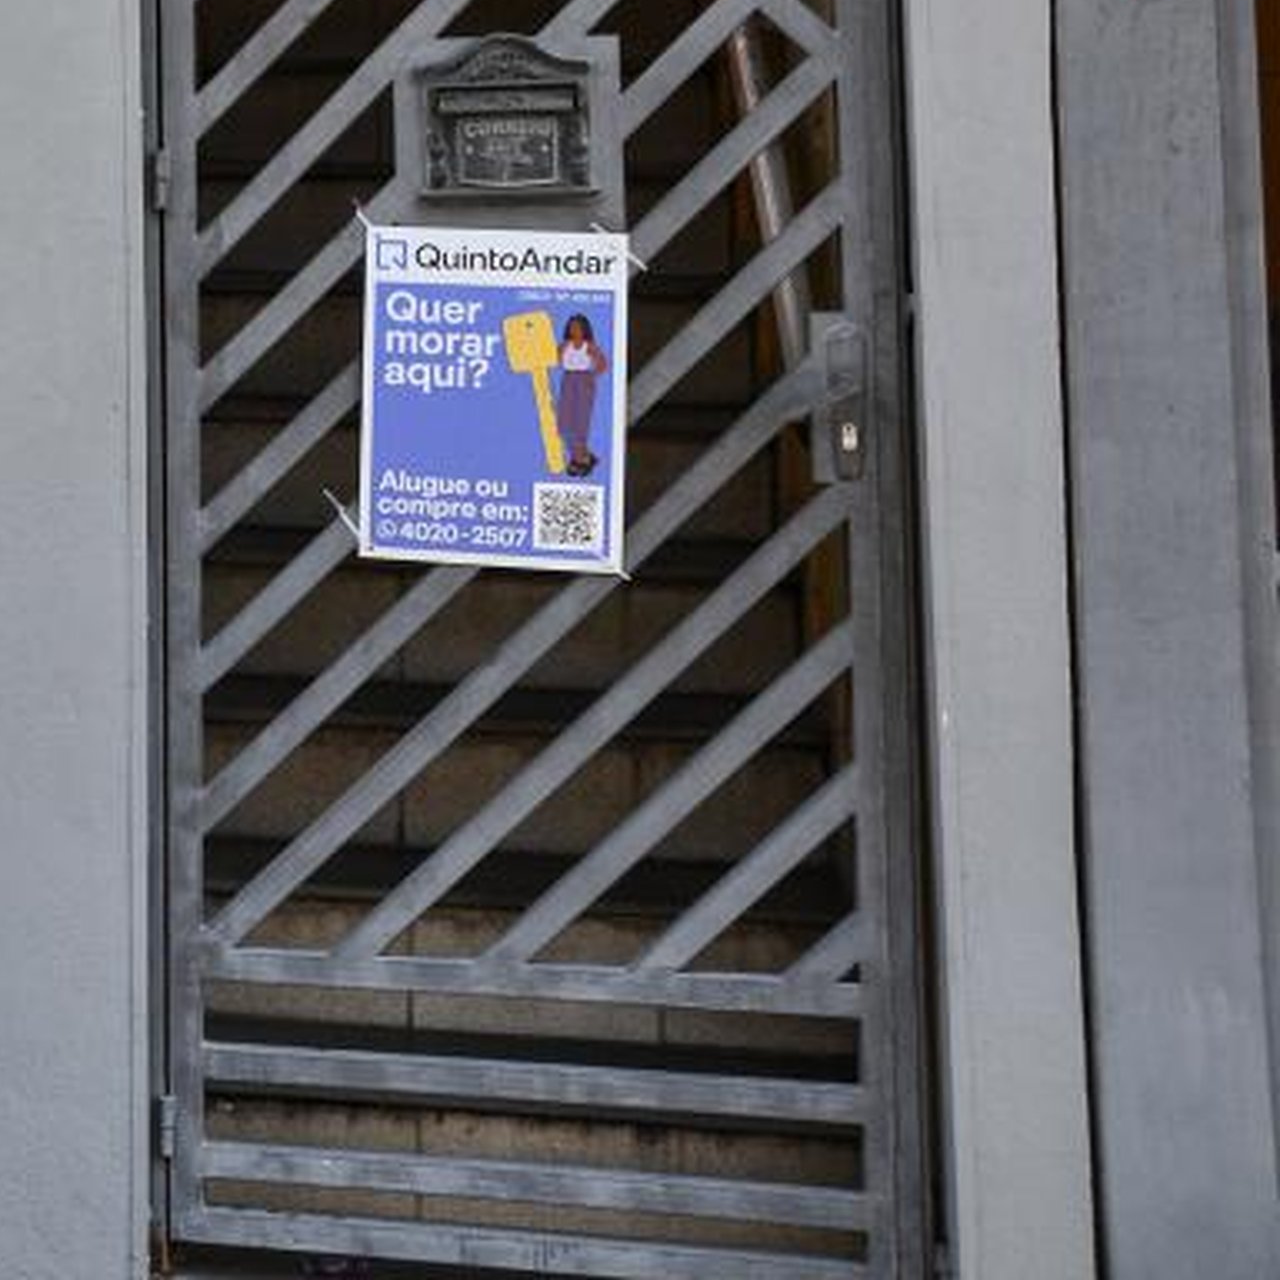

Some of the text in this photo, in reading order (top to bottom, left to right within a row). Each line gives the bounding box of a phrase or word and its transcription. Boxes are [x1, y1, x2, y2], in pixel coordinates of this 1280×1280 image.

[415, 242, 617, 275] QuintoAndar
[385, 290, 484, 325] Quer
[385, 330, 501, 358] morar
[383, 357, 489, 395] aqui?
[378, 469, 509, 498] Alugue ou
[376, 497, 530, 524] compre em:
